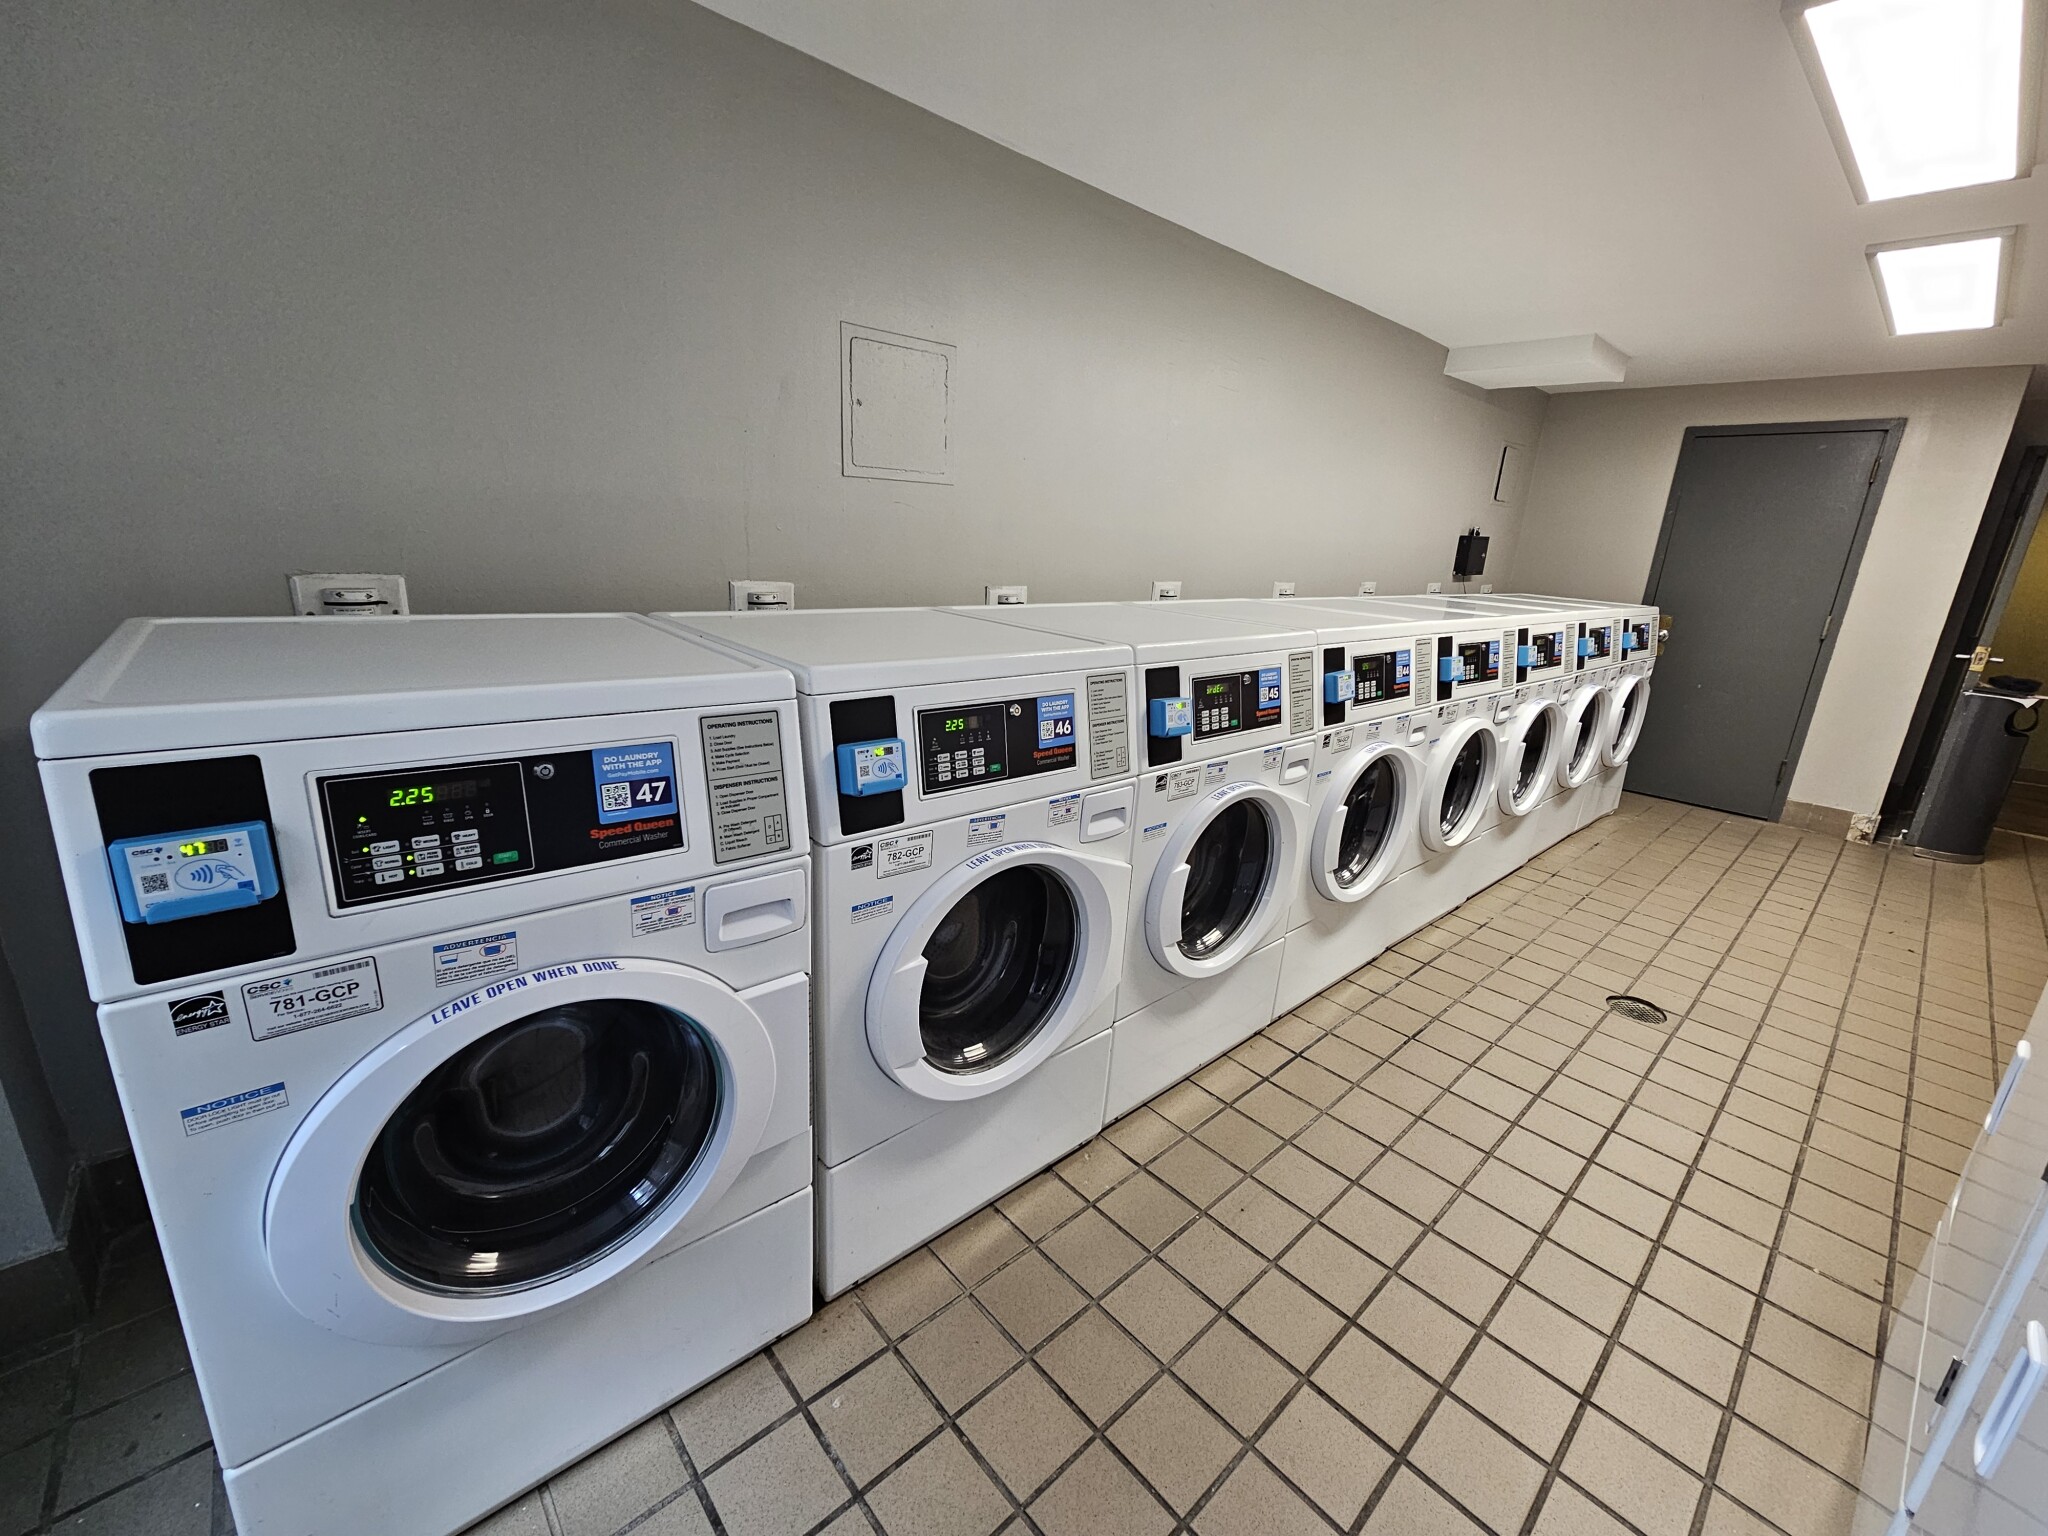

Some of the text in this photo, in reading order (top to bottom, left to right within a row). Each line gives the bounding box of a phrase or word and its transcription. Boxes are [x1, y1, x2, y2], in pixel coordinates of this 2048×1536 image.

[1269, 687, 1278, 699] 45
[707, 718, 773, 730] OPERATING INSTRUCTIONS
[1055, 720, 1071, 735] 46
[619, 752, 658, 762] LAUNDRY
[1033, 746, 1073, 758] Speed Queen
[602, 762, 626, 771] WITH
[714, 776, 778, 790] DISPENSER INSTRUCTIONS
[389, 786, 434, 807] 2.25
[636, 781, 666, 803] 47
[590, 818, 674, 840] Speed Queen
[599, 831, 669, 849] Commercial Washer
[887, 847, 924, 862] 782-GCP
[966, 854, 994, 870] LEAVE
[991, 846, 1014, 857] OPEN
[650, 891, 677, 900] NOTICE
[443, 934, 507, 950] ADVERTENCIA
[247, 981, 281, 995] CSC
[431, 961, 620, 1025] LEAVE OPEN WHEN DONE
[269, 982, 360, 1013] 781-GCP
[293, 1003, 342, 1018] 1-877-264-6622
[176, 1018, 230, 1035] ENERGY STAR
[197, 1086, 272, 1114] NOTICE
[187, 1114, 207, 1123] DOOR
[208, 1109, 227, 1117] LOCK
[227, 1103, 247, 1112] LIGHT
